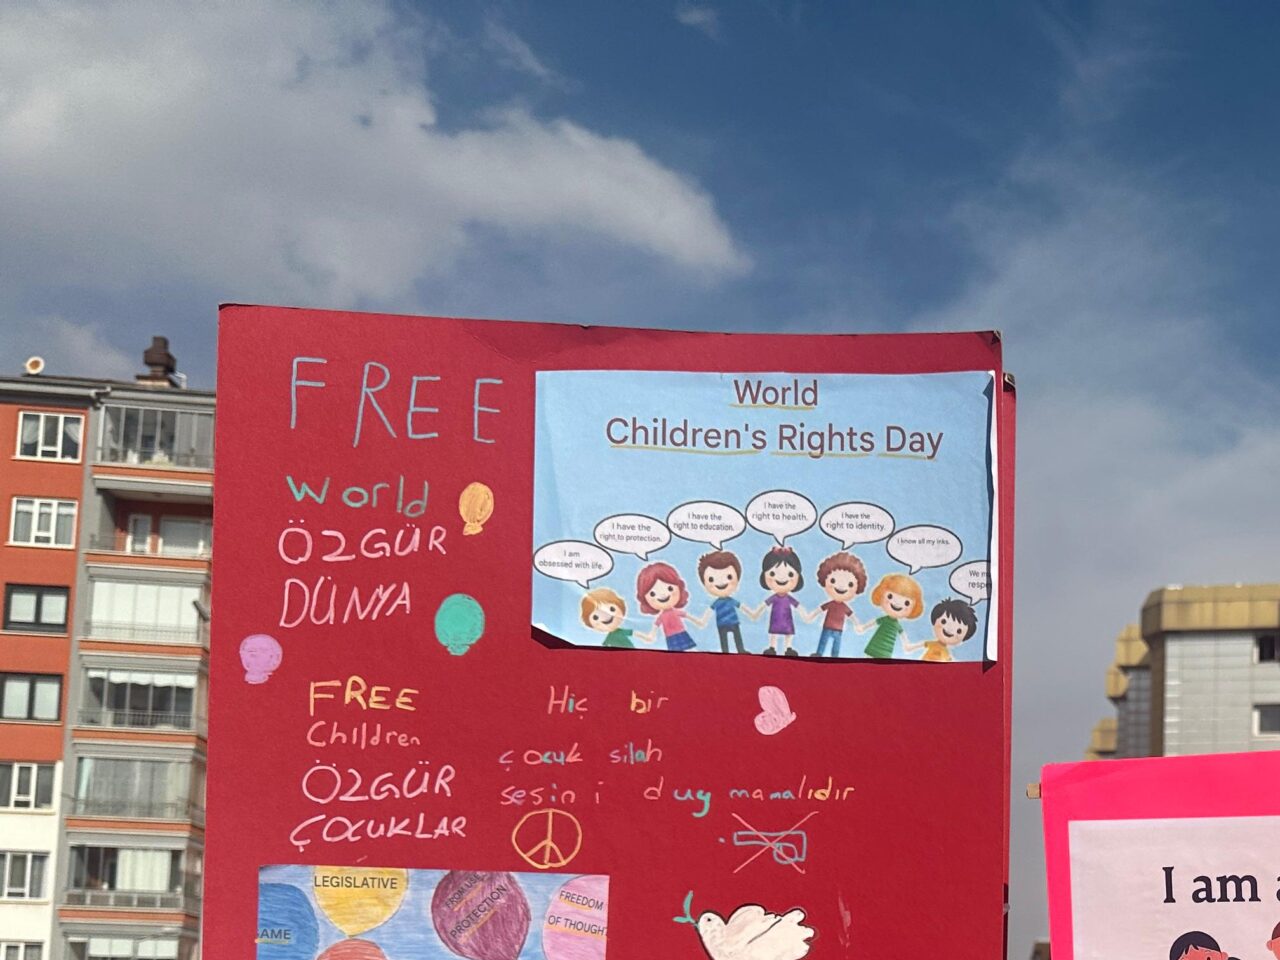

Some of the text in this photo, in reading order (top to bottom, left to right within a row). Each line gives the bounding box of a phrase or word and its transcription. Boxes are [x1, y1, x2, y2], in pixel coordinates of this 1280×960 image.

[290, 356, 503, 447] FREE
[733, 379, 818, 406] World
[606, 417, 944, 459] Children's Rights Day
[710, 513, 722, 521] the
[752, 513, 770, 521] right
[767, 502, 784, 510] have
[785, 502, 796, 510] the
[617, 523, 636, 531] have
[638, 523, 651, 532] the
[673, 522, 689, 530] right
[691, 522, 698, 530] to
[826, 520, 848, 530] right
[278, 519, 447, 565] ÖZGÜR
[538, 560, 573, 569] obsessed
[574, 561, 590, 569] with
[279, 576, 411, 628] DÜNYA
[309, 676, 419, 717] FREE
[631, 690, 669, 714] bir
[609, 738, 662, 765] silah
[302, 760, 456, 804] ÖZGÜR
[289, 814, 468, 853] ÇOCUKLAR
[313, 875, 398, 890] LEGISLATIVE
[1162, 866, 1176, 903] I
[1191, 874, 1261, 903] am
[449, 883, 508, 940] PROTECTION
[560, 890, 604, 911] FREEDOM
[547, 915, 562, 926] OF
[257, 928, 292, 940] AME
